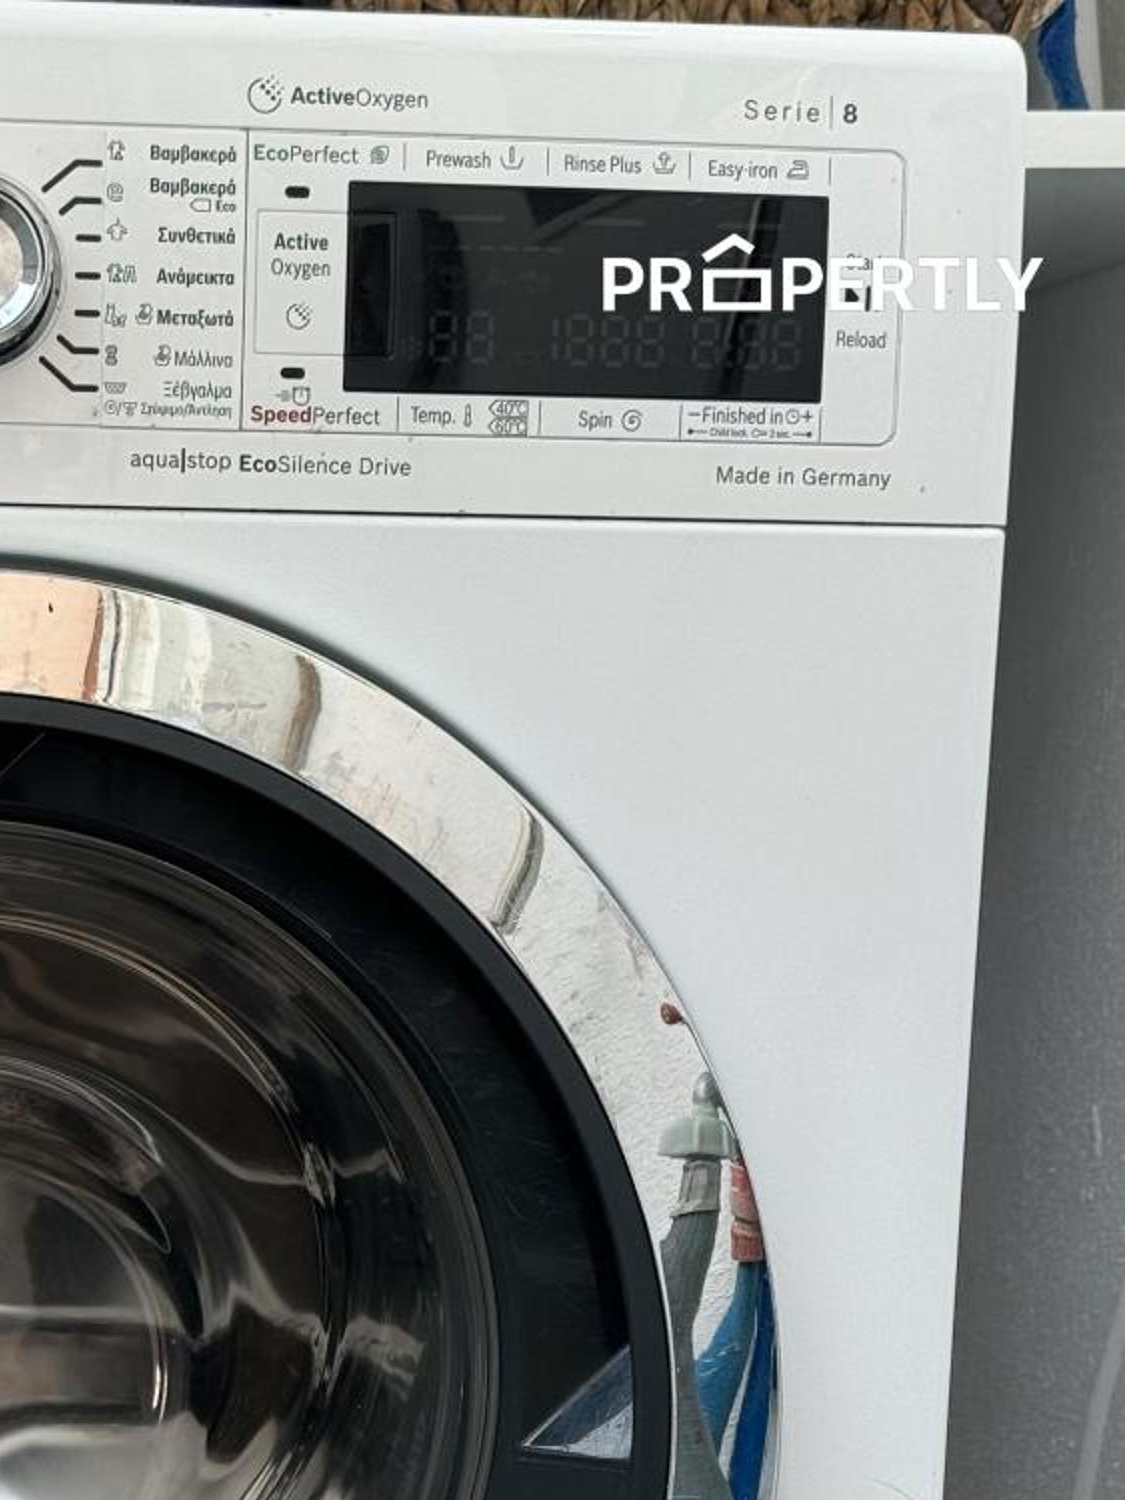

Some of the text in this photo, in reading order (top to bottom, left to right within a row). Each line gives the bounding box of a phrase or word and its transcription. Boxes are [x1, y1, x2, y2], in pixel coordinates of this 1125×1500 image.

[290, 86, 429, 111] ActiveOxygen
[743, 99, 859, 124] Serie 8
[149, 144, 238, 166] Βαμβακερά
[253, 144, 360, 165] EcoPerfect
[426, 149, 492, 169] Prewash
[564, 153, 642, 174] Rinse Plus
[149, 177, 237, 198] Βαμβακερά
[157, 227, 236, 245] Συνθετικά
[274, 232, 330, 251] Active
[156, 268, 235, 289] Ανάμεικτα
[270, 257, 332, 281] Oxygen
[156, 308, 234, 329] Μεταξωτά
[836, 329, 888, 349] Reload
[174, 349, 234, 368] Μάλλινα
[163, 381, 232, 401] Ξέβγαλμα
[250, 404, 381, 426] SpeedPerfect
[411, 405, 456, 425] Temp.
[578, 410, 613, 431] Spin
[701, 405, 766, 425] Finished
[239, 454, 352, 475] EcoSilence
[359, 457, 412, 476] Drive
[716, 466, 892, 490] Made in Germany
